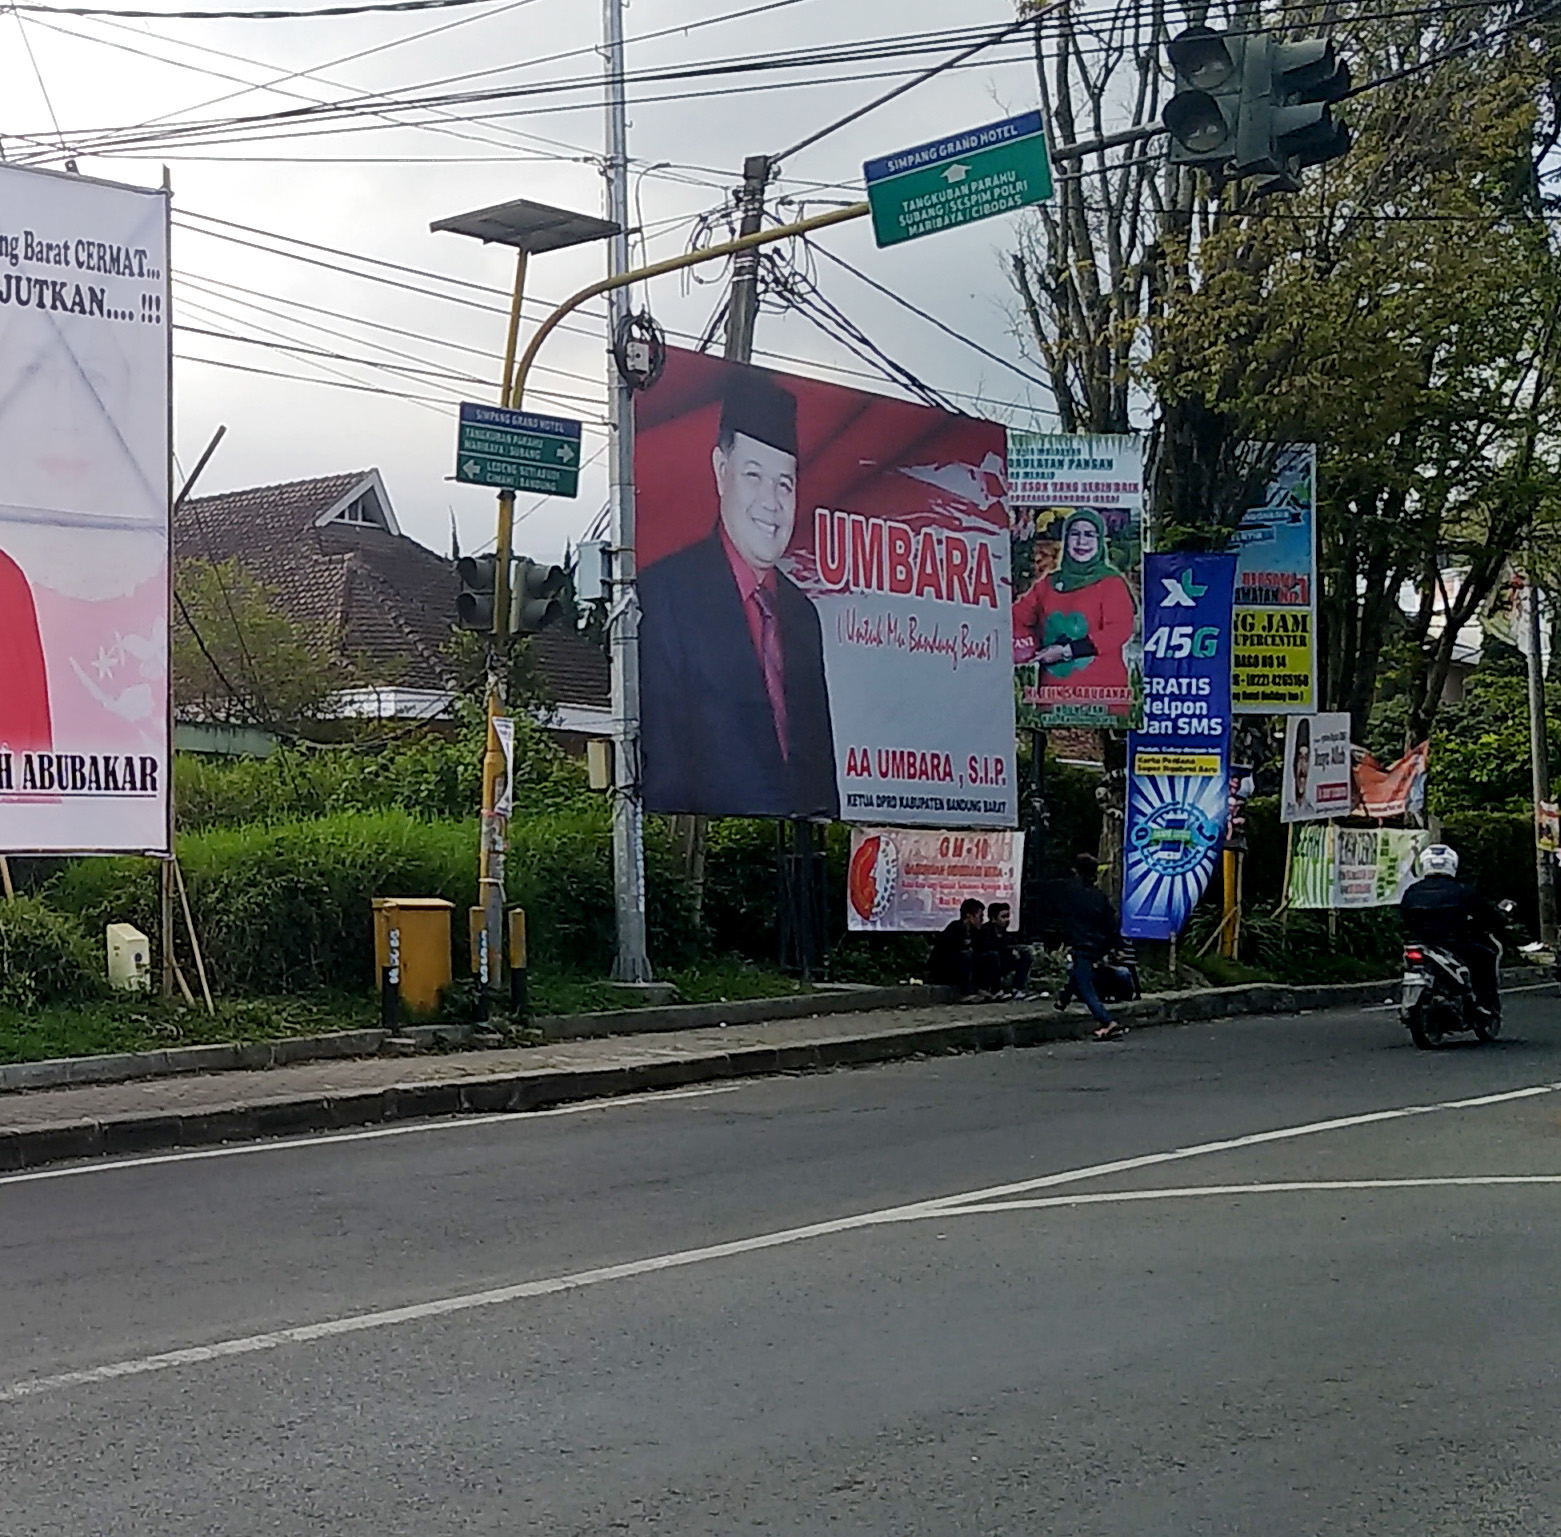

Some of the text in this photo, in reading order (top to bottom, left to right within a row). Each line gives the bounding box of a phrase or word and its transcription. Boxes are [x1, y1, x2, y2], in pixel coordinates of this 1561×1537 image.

[887, 125, 1018, 172] SIMPANG GRAND HOTEL
[901, 171, 1016, 212] TANGKUBAN PARAHU
[971, 195, 1022, 219] CIBODAS
[993, 180, 1028, 199] POLRI
[23, 230, 71, 268] Barat
[1021, 481, 1048, 493] ESOK
[1052, 481, 1079, 493] YANG
[1081, 481, 1112, 494] LEBIH
[1113, 481, 1139, 494] BAIK
[815, 508, 999, 611] UMBARA
[1160, 568, 1208, 607] XL
[1262, 614, 1309, 633] JAM
[909, 616, 958, 671] Bandung
[1177, 717, 1223, 736] SMS
[21, 752, 160, 793] ABUBAKAR
[846, 747, 872, 777] AA
[878, 749, 954, 782] UMBARA
[846, 793, 1007, 814] KETUA DPRD KABUPATEN BANDUNG BARAT
